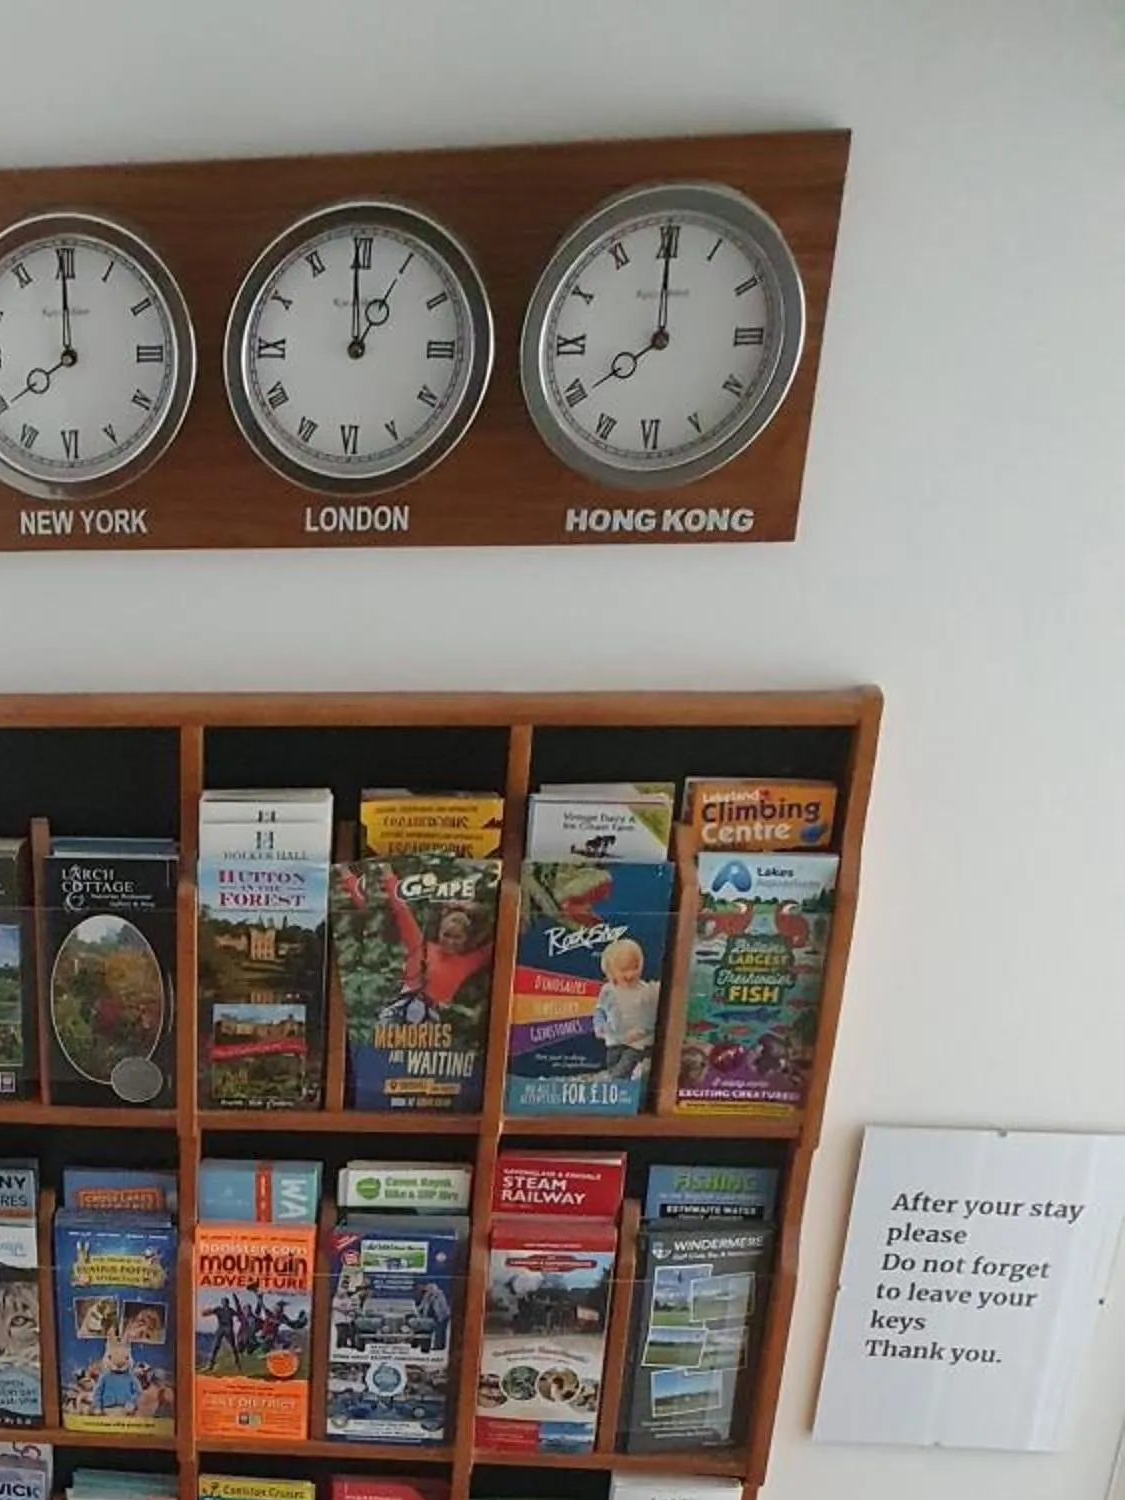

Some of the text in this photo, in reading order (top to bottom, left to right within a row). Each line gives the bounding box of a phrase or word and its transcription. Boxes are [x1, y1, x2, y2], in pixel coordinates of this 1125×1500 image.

[306, 251, 326, 277] XI
[609, 243, 630, 270] XI
[12, 262, 32, 287] XI
[572, 286, 594, 304] X
[734, 277, 758, 296] II
[131, 298, 152, 316] II
[271, 290, 293, 310] X
[426, 292, 447, 310] II
[557, 334, 586, 356] IX
[734, 328, 764, 346] III
[137, 346, 163, 363] III
[258, 338, 286, 359] IX
[427, 340, 455, 358] III
[416, 385, 437, 407] IV
[722, 374, 743, 398] IV
[132, 389, 152, 411] IV
[103, 424, 118, 443] V
[298, 416, 318, 442] VII
[384, 420, 397, 440] V
[595, 413, 617, 440] VII
[687, 413, 702, 432] V
[21, 424, 39, 448] VII
[61, 430, 79, 458] VI
[340, 425, 359, 455] VI
[641, 419, 660, 449] VI
[20, 509, 148, 534] NEW YORK
[305, 506, 409, 532] LONDON
[565, 508, 754, 532] HONG KONG
[703, 800, 821, 822] Climbing
[701, 822, 791, 844] Centre
[62, 867, 114, 880] LARCH
[757, 867, 794, 877] Lakes
[62, 881, 135, 893] COTTAGE
[220, 892, 305, 906] FOREST
[729, 986, 779, 1002] FISH
[375, 1023, 452, 1048] MEMORIES
[408, 1052, 475, 1078] WAITING
[503, 1176, 567, 1191] STEAM
[502, 1190, 586, 1205] RAILWAY
[891, 1192, 1085, 1225] After your stay
[674, 1236, 764, 1251] WINDERMERE
[886, 1222, 968, 1247] please
[200, 1253, 307, 1276] mountain
[881, 1253, 1052, 1283] Do not forget
[200, 1276, 307, 1289] ADVENTURE
[875, 1282, 1038, 1309] to leave your
[869, 1310, 927, 1335] keys
[864, 1339, 1003, 1367] Thank you.
